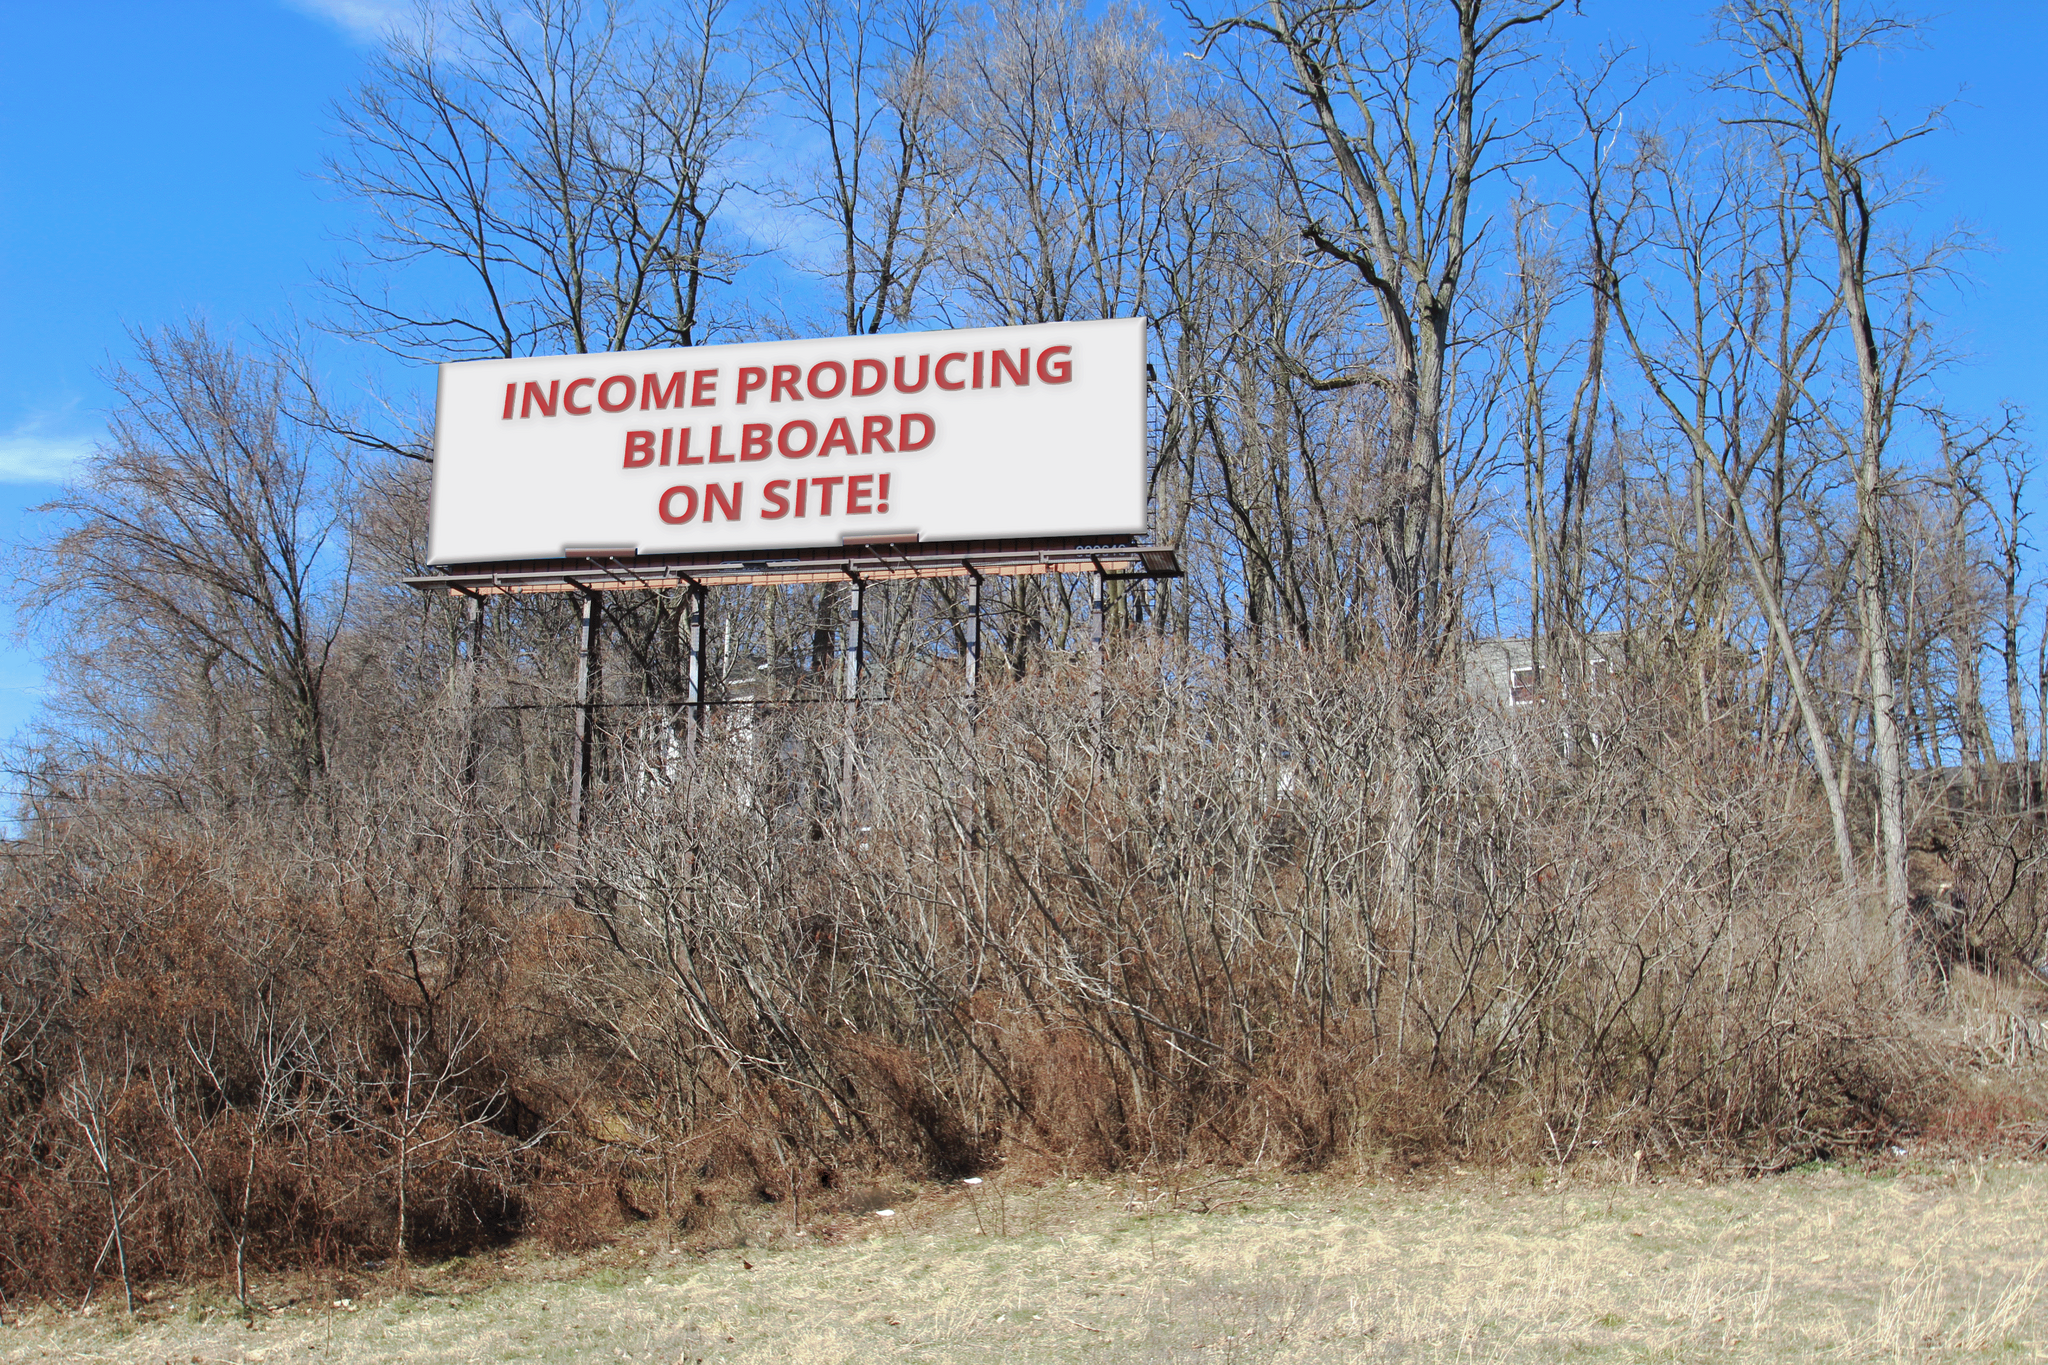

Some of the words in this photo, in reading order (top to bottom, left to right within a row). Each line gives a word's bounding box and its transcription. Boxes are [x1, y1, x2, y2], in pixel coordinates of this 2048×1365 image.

[502, 368, 719, 421] INCOME
[735, 344, 1074, 405] PRODUCING
[622, 411, 936, 470] BILLBOARD
[657, 480, 744, 526] ON
[759, 472, 892, 520] SITE!
